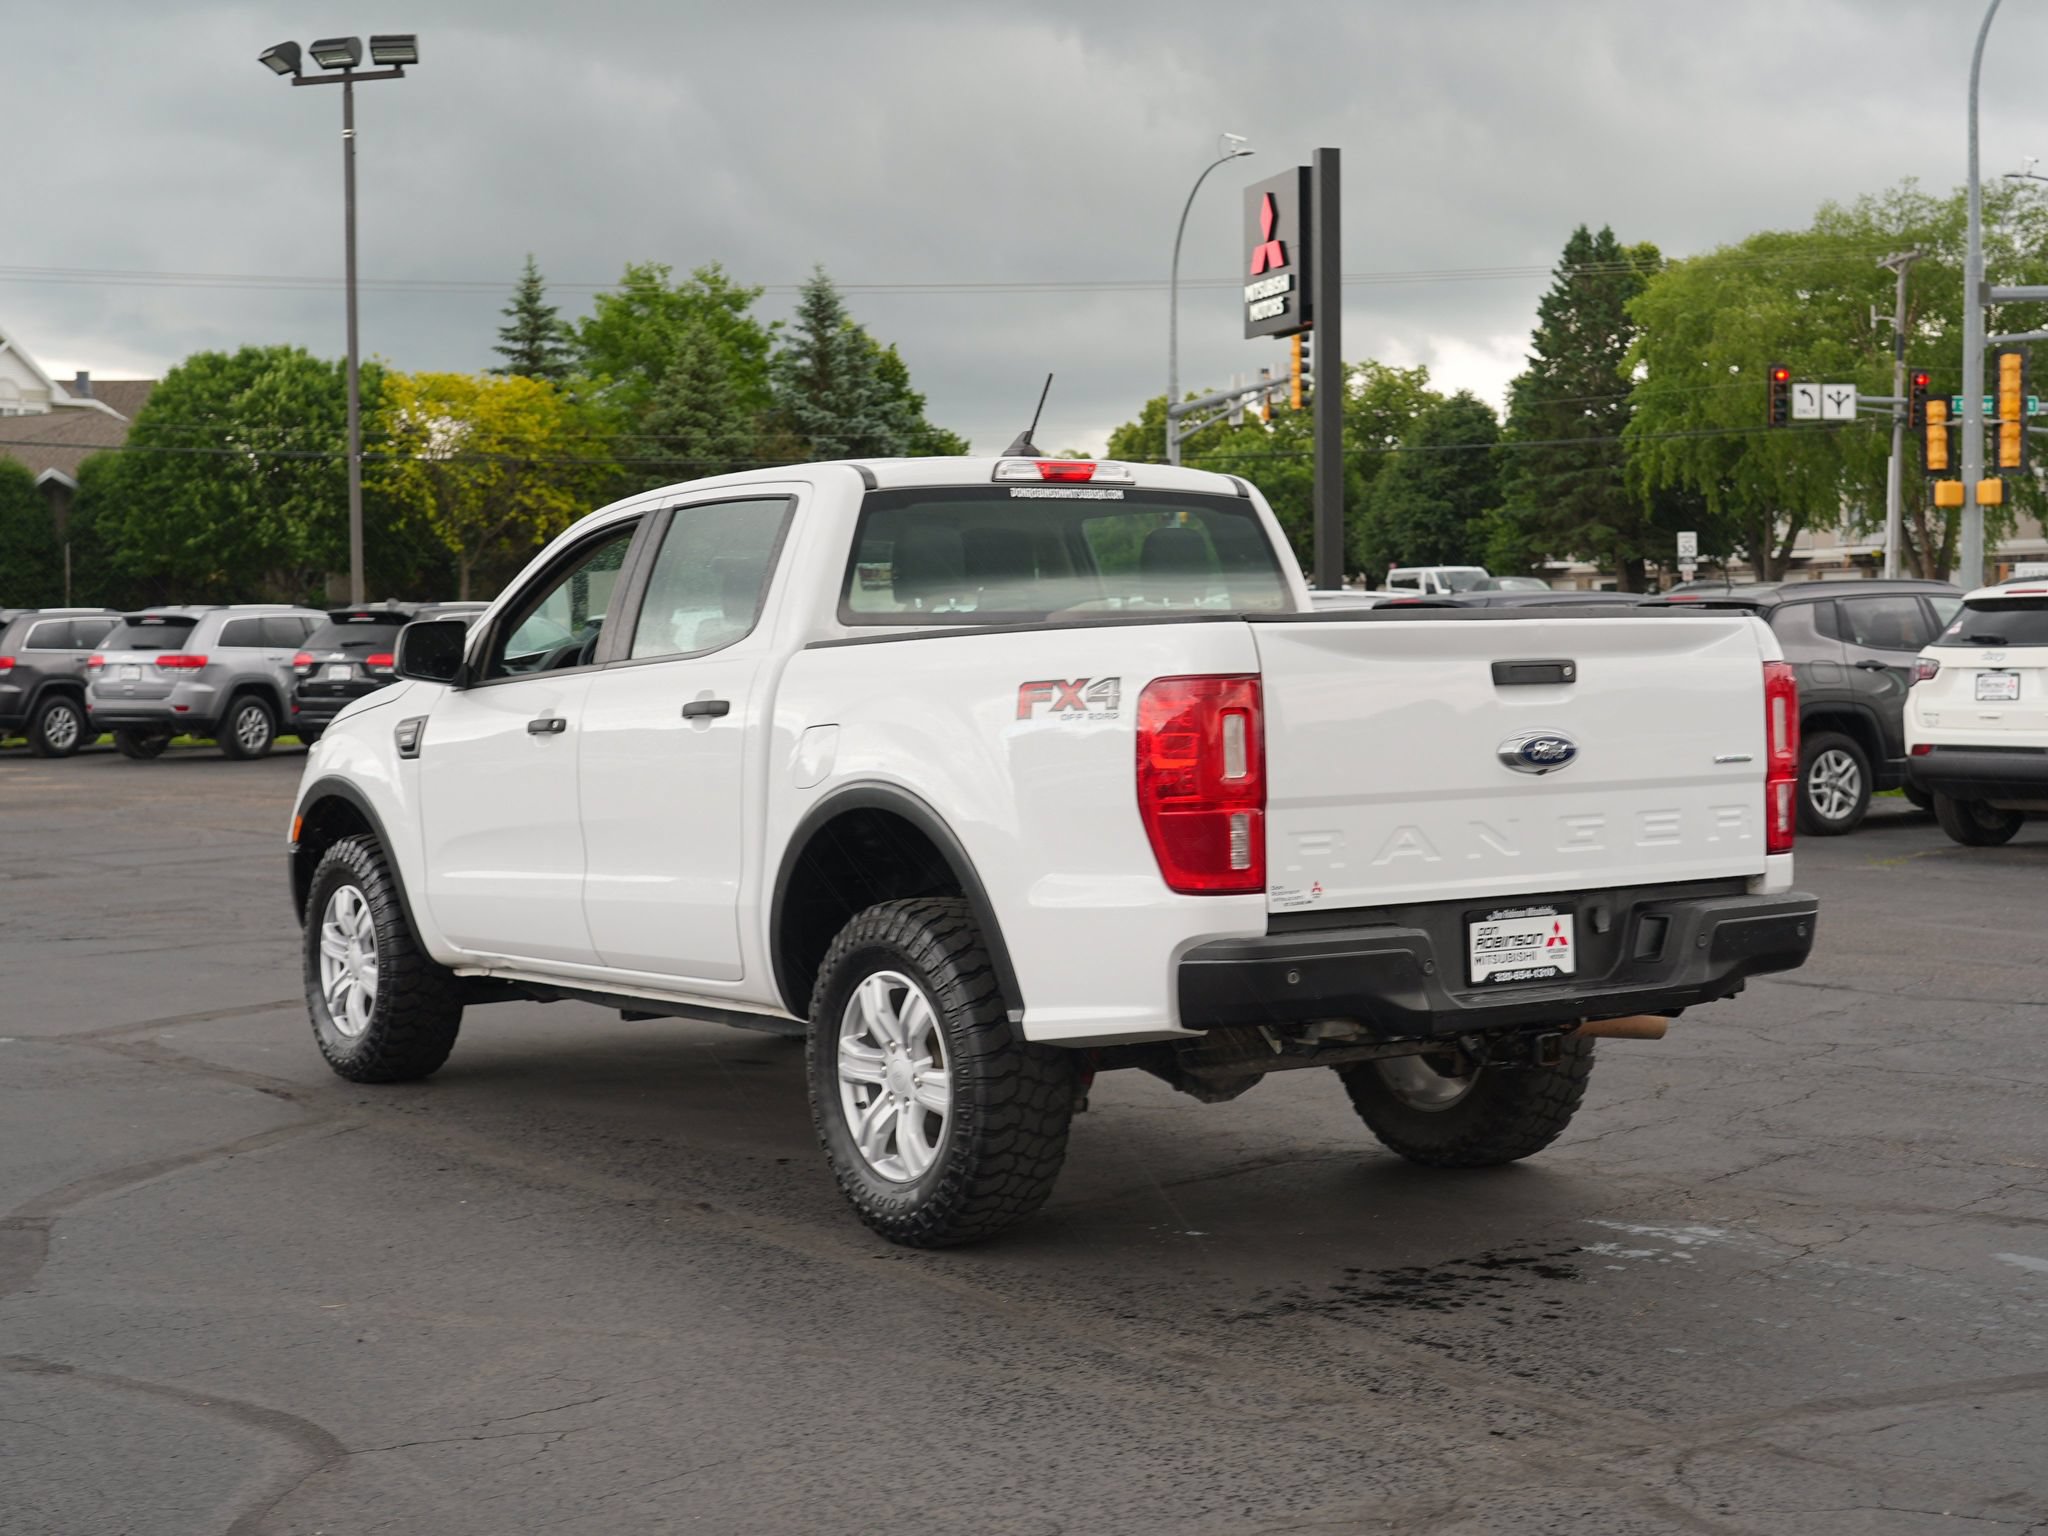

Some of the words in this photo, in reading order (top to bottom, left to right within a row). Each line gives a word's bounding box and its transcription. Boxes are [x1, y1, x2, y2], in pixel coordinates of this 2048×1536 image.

[1016, 676, 1121, 721] FX4
[1531, 740, 1568, 760] Ford
[1286, 803, 1752, 871] RANGER
[1474, 952, 1538, 966] MITSUBISHI
